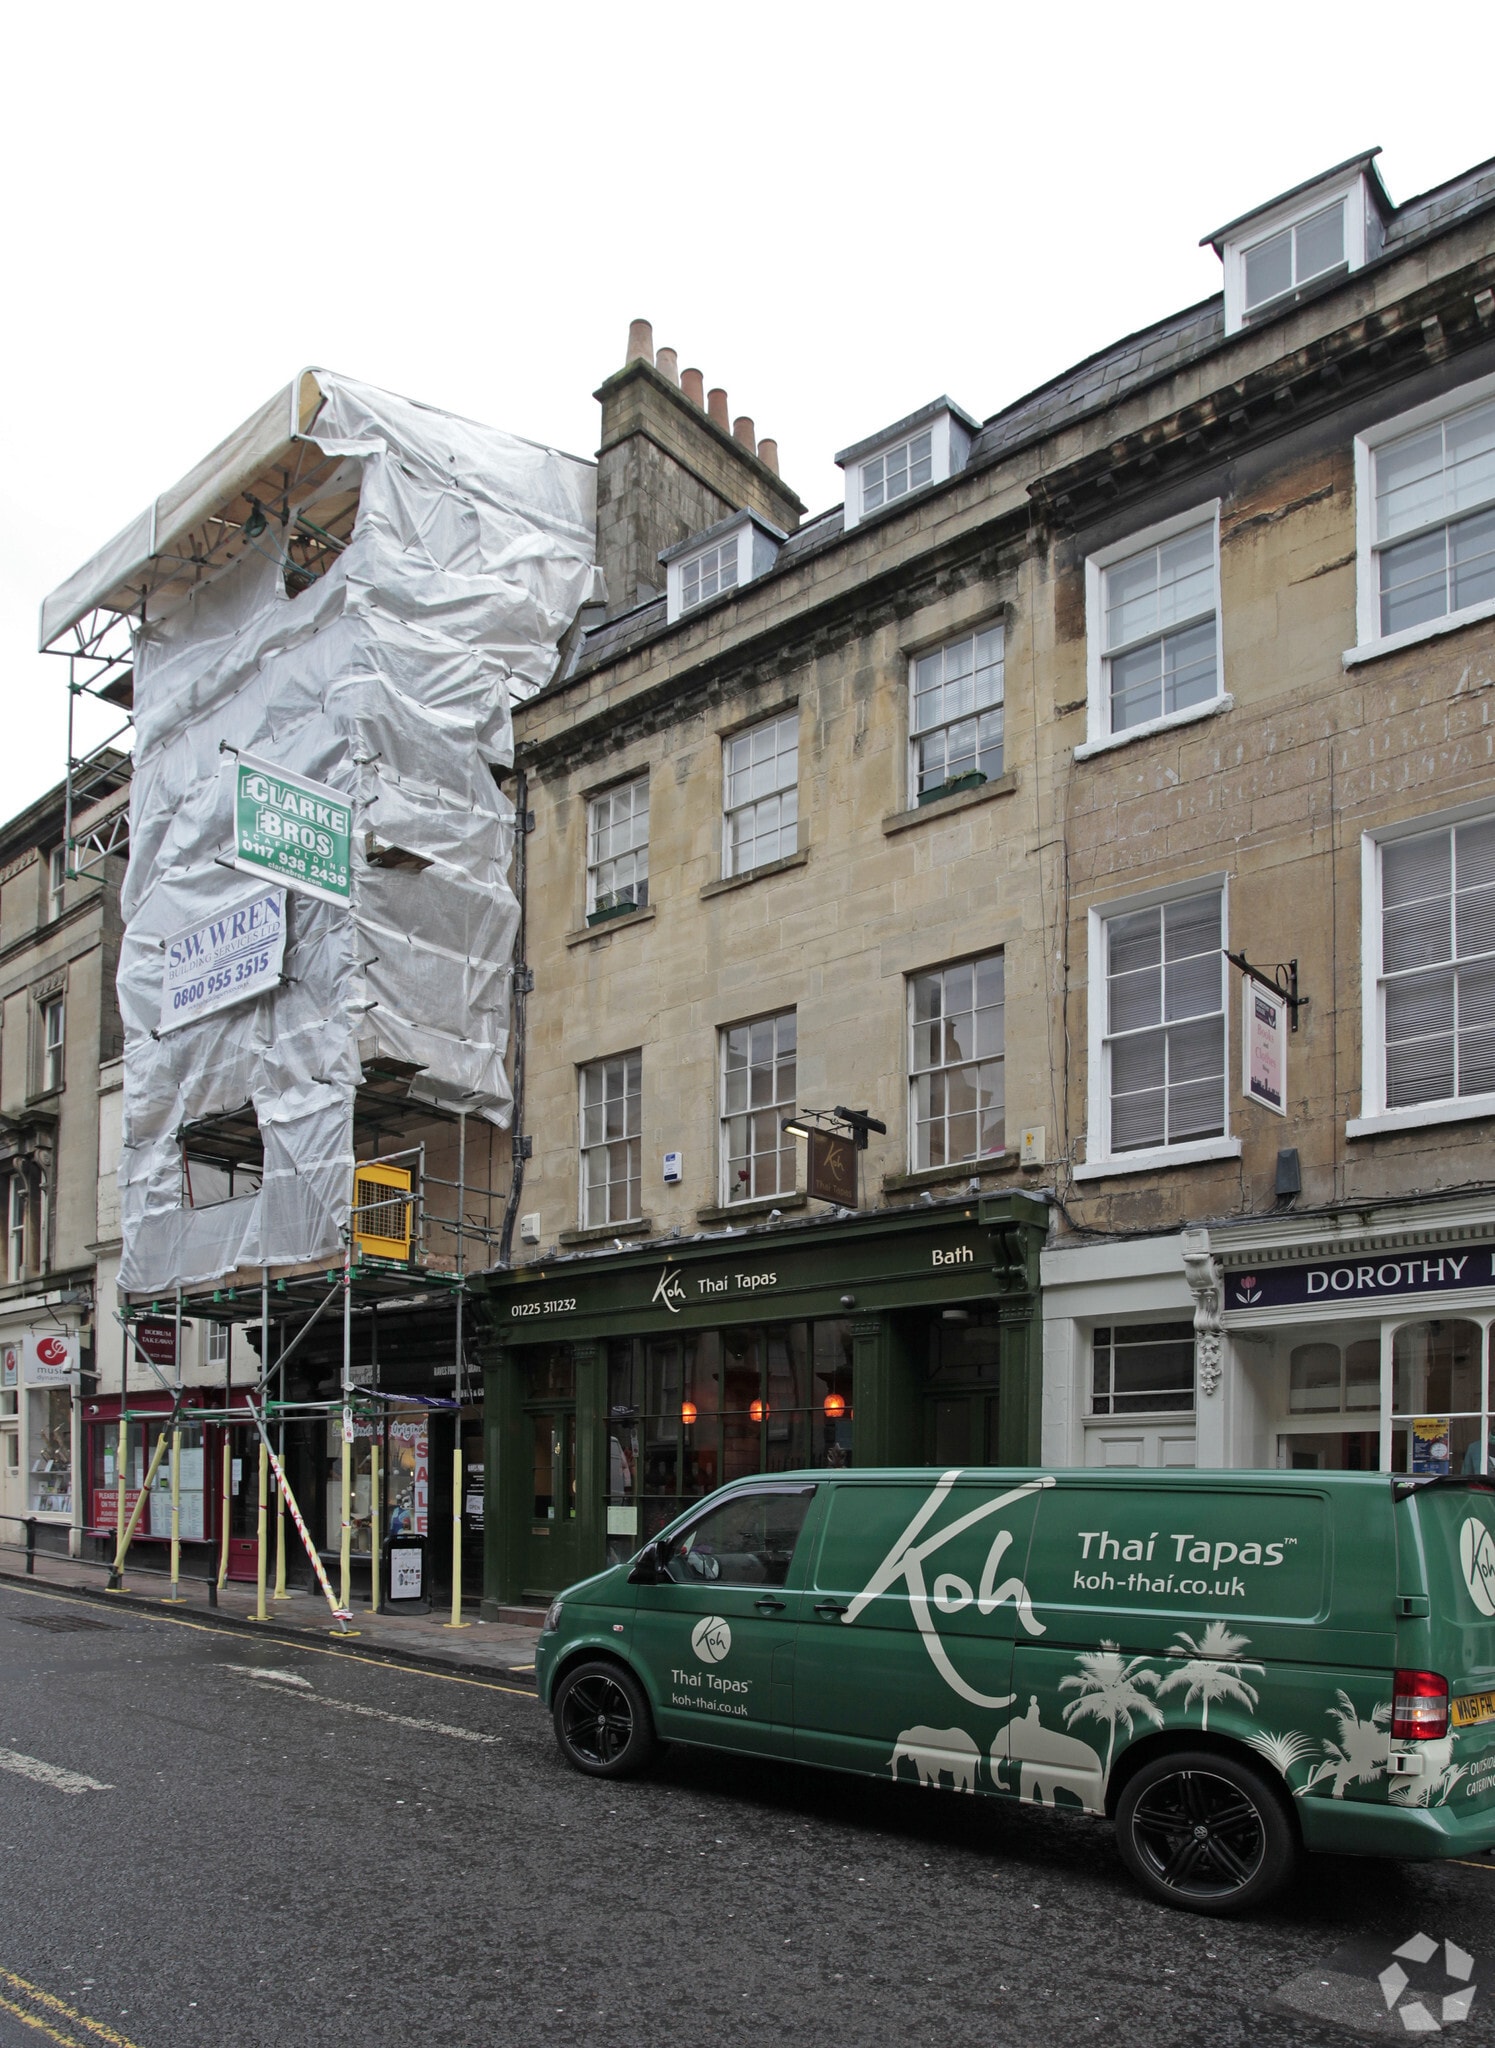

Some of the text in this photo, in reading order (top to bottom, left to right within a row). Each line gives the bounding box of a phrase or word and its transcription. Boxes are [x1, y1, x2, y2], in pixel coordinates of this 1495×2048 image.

[245, 775, 345, 834] CLARKE
[242, 829, 347, 874] SCAFFOLDING
[260, 809, 330, 857] BROS
[242, 839, 348, 888] 0117 938 2439
[209, 891, 284, 950] WREN
[168, 921, 281, 981] BUILDING SERVICES LTD
[173, 980, 205, 1010] 0800
[207, 967, 233, 995] 955
[235, 951, 270, 983] 3515
[823, 1140, 846, 1182] Koh
[931, 1245, 974, 1266] Bath
[1306, 1255, 1469, 1294] DOROTHY
[511, 1298, 577, 1317] 01225 311232
[651, 1265, 687, 1313] Koh
[734, 1271, 778, 1290] Tapas
[142, 1336, 175, 1345] TAKEAWAY
[144, 1329, 172, 1337] BODRUM
[391, 1420, 428, 1441] Original
[98, 1492, 115, 1500] PLEASE
[415, 1441, 429, 1533] SALE
[840, 1470, 1057, 1709] Koh
[695, 1615, 728, 1662] Koh
